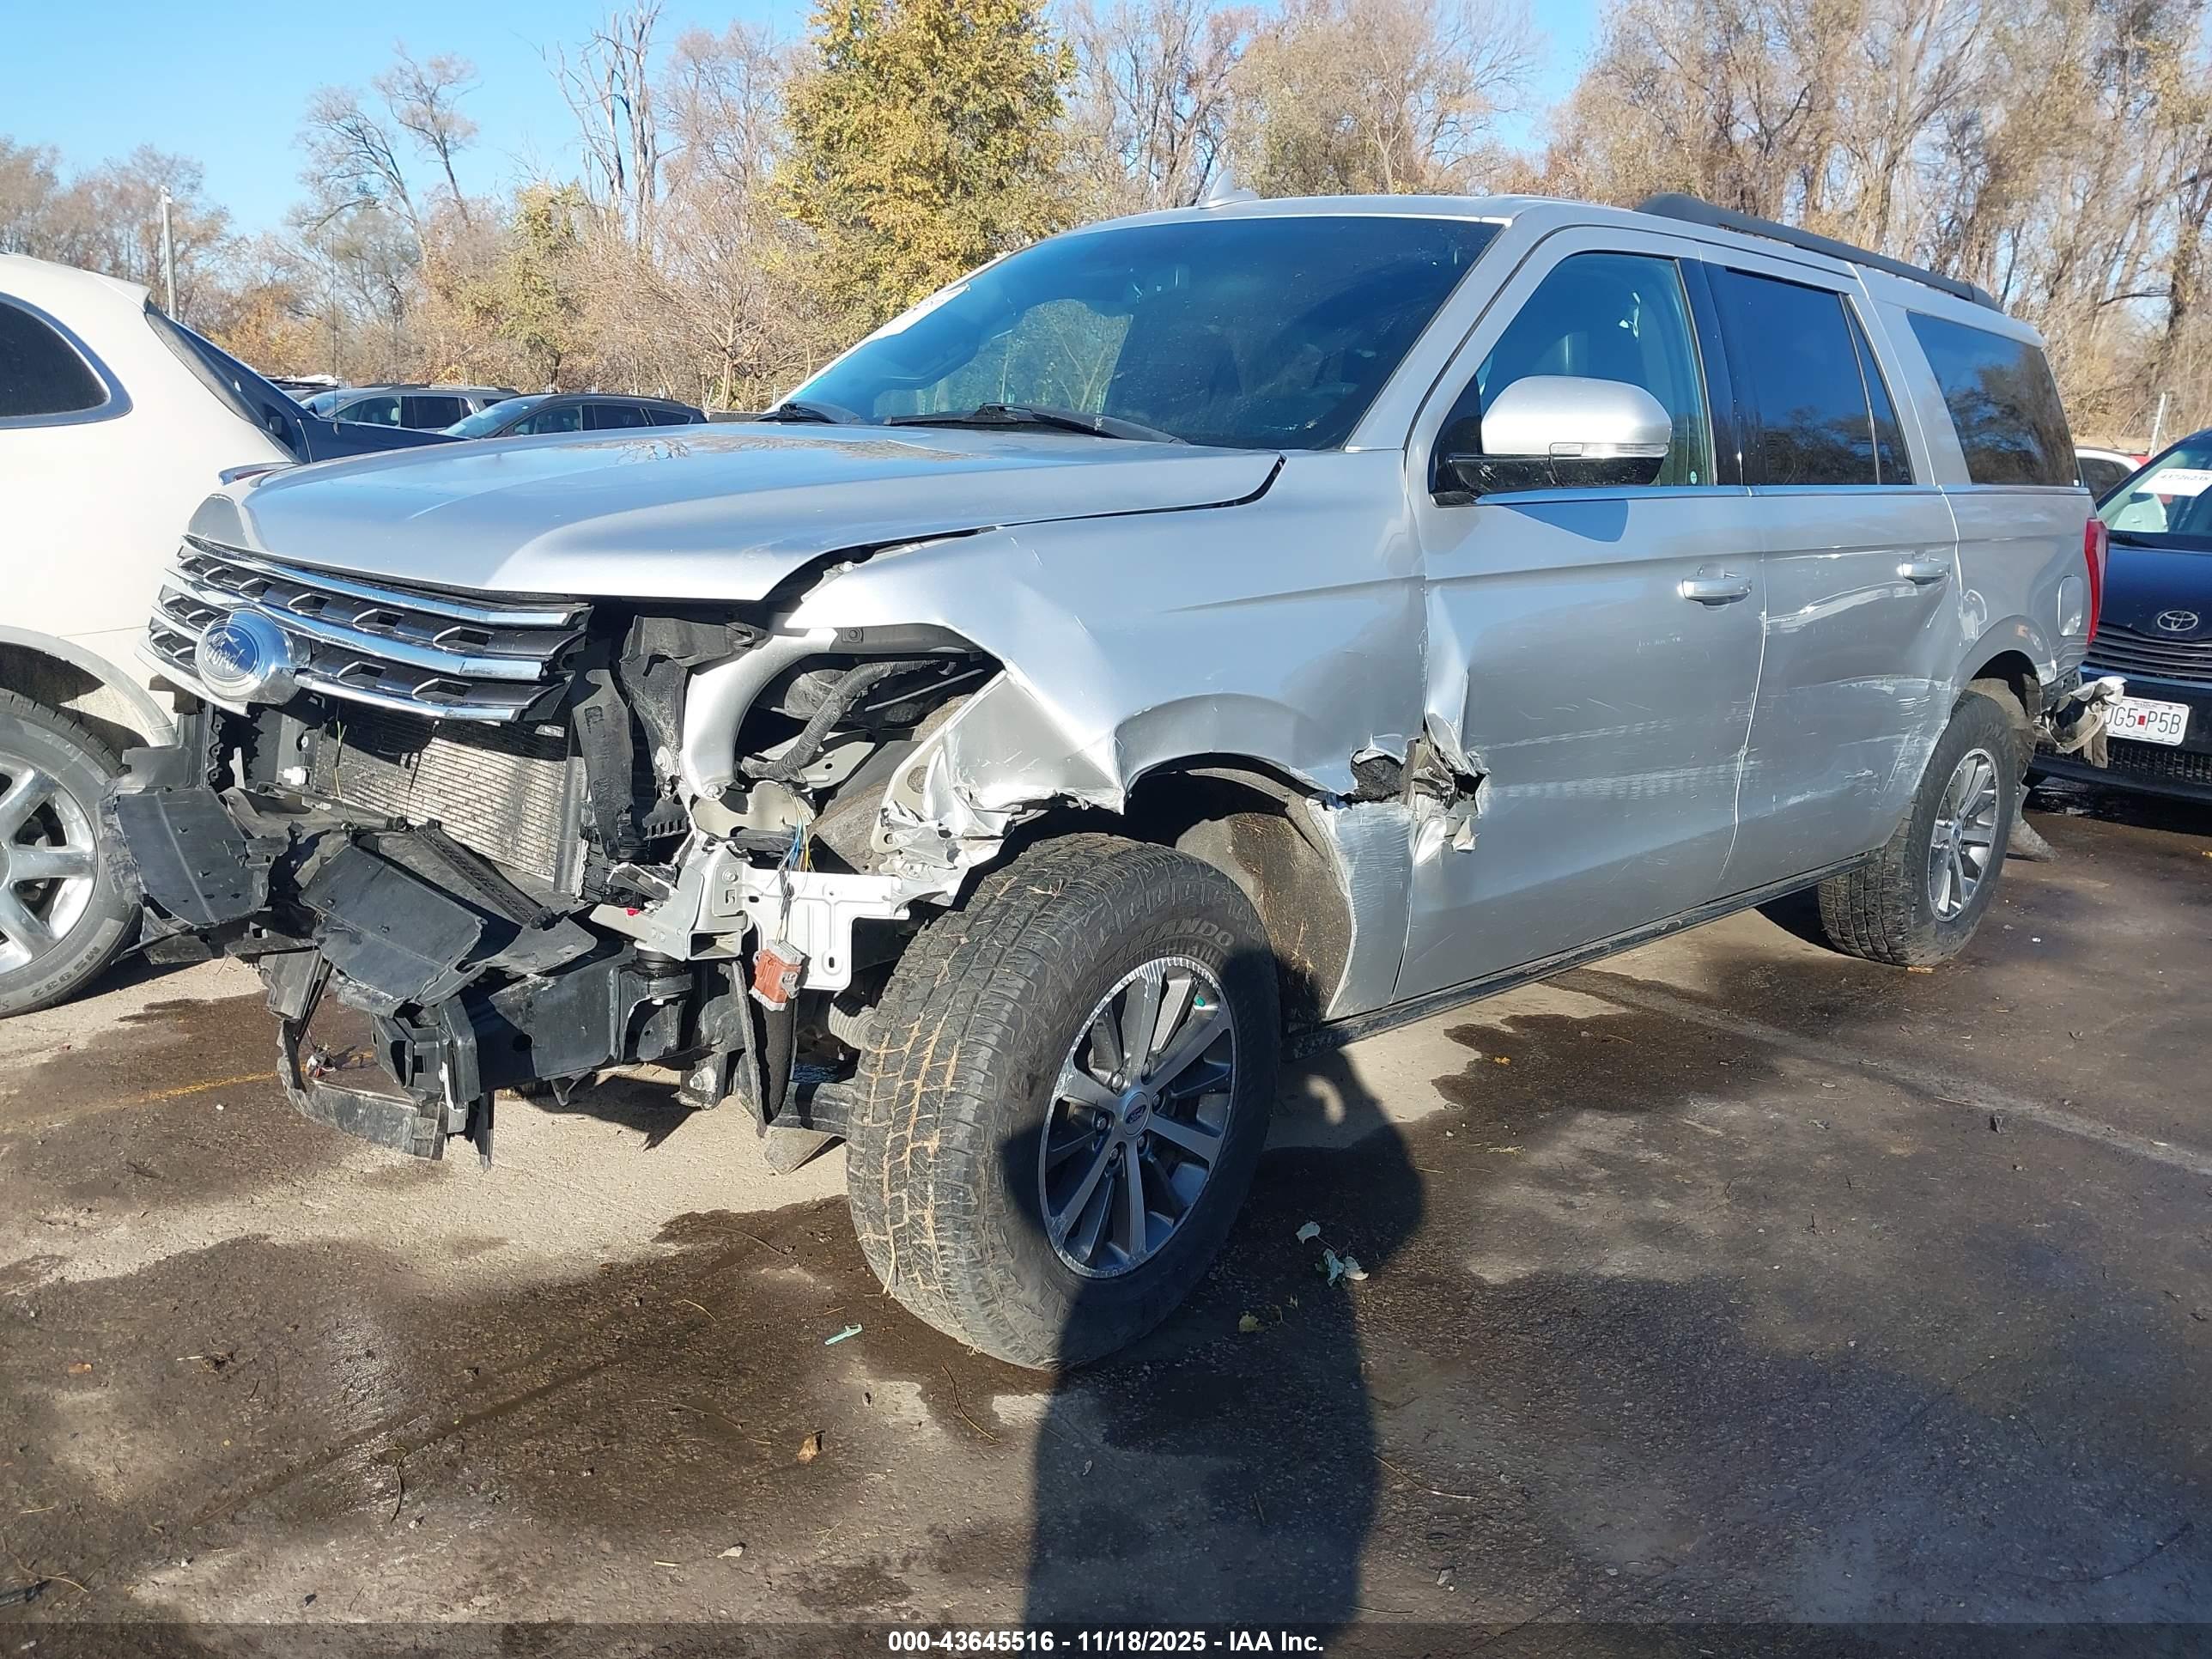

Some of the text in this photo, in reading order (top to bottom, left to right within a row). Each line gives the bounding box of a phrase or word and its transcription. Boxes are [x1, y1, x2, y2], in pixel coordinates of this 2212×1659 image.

[204, 630, 246, 672] Ford
[2145, 710, 2182, 734] P5B
[1061, 917, 1234, 1039] COMMANDO
